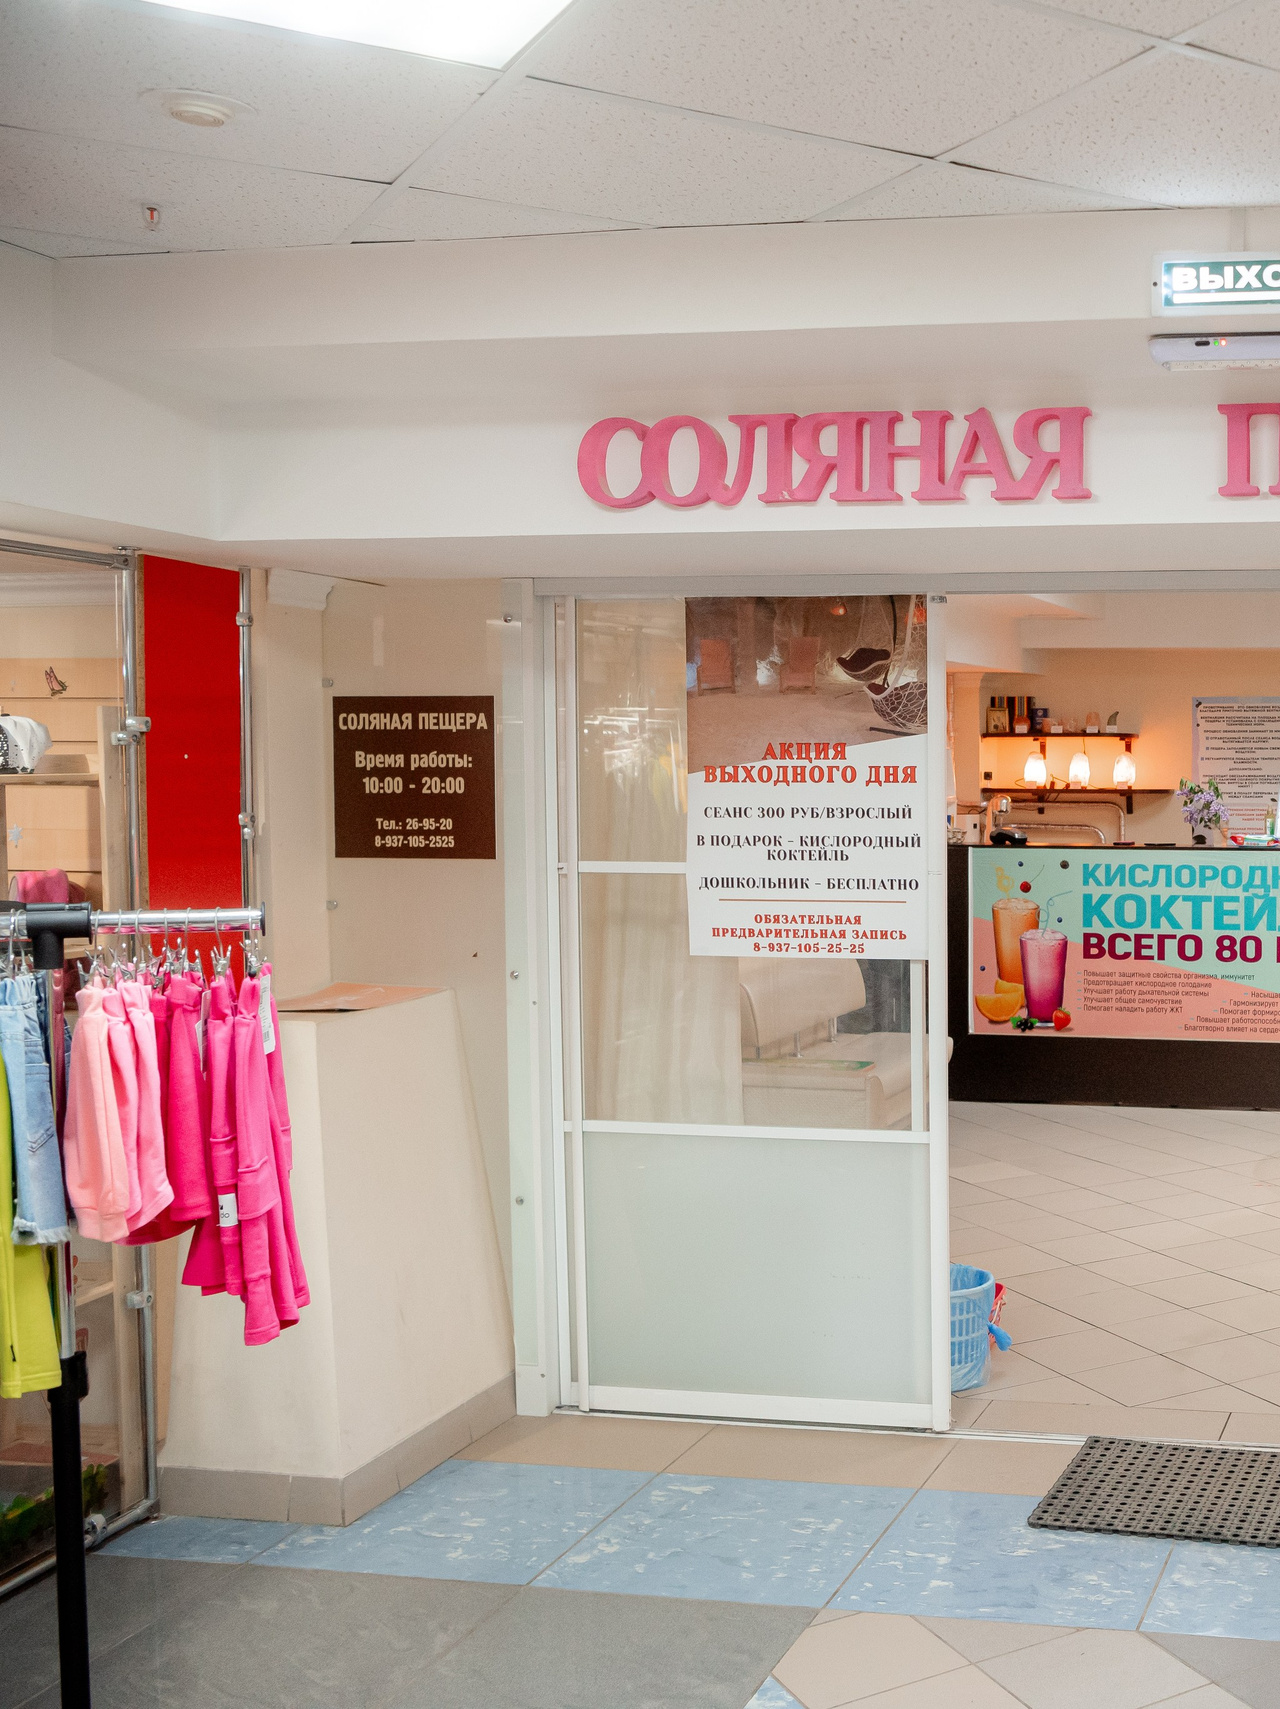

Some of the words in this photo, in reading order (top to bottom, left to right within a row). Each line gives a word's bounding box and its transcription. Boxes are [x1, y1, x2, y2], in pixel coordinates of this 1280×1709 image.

[576, 406, 1092, 508] СОЛЯНАЯ
[338, 712, 412, 730] СОЛЯНАЯ
[418, 712, 488, 732] ПЕЩЕРА
[762, 742, 847, 763] АКЦИЯ
[355, 750, 405, 771] Время
[410, 750, 473, 771] работы:
[703, 765, 857, 786] ВЫХОДНОГО
[865, 765, 918, 787] ДНЯ
[362, 776, 403, 794] 10:00
[421, 776, 465, 794] 20:00
[703, 806, 753, 819] СЕАНС
[757, 806, 785, 819] 300
[790, 804, 912, 820] РУБ/ВЗРОСЛЫЙ
[376, 818, 402, 830] Тел.:
[406, 818, 452, 830] 26-95-20
[374, 835, 455, 848] 8-937-105-2525
[696, 834, 705, 846] В
[710, 834, 782, 848] ПОДАРОК
[799, 833, 922, 850] КИСЛОРОДНЫЙ
[766, 846, 850, 862] КОКТЕЙЛЬ
[698, 876, 810, 890] ДОШКОЛЬНИК
[826, 878, 920, 891] БЕСПЛАТНО
[754, 913, 862, 925] ОБЯЗАТЕЛЬНАЯ
[711, 927, 846, 940] ПРЕДВАРИТЕЛЬНАЯ
[851, 929, 907, 940] ЗАПИСЬ
[753, 942, 865, 954] 8-937-105-25-25
[1082, 932, 1203, 962] ВСЕГО
[1214, 934, 1262, 963] 80
[1083, 970, 1116, 978] Повышает
[1118, 971, 1151, 979] защитные
[1152, 971, 1182, 980] свойства
[1183, 972, 1220, 981] организма,
[1083, 978, 1134, 987] Предотвращает
[1134, 980, 1176, 989] кислородное
[1178, 981, 1212, 989] голодание
[1083, 987, 1113, 996] Улучшает
[1114, 988, 1136, 996] работу
[1138, 988, 1180, 997] дыхательной
[1083, 996, 1113, 1004] Улучшает
[1114, 996, 1137, 1004] общее
[1138, 998, 1182, 1006] самочувствие
[1229, 999, 1279, 1008] Гармонизирует
[1083, 1004, 1113, 1013] Помогает
[1114, 1006, 1144, 1014] наладить
[1146, 1006, 1168, 1014] работу
[1219, 1008, 1250, 1016] Помогает
[1196, 1016, 1230, 1024] Повышает
[1184, 1024, 1225, 1032] Благотворно
